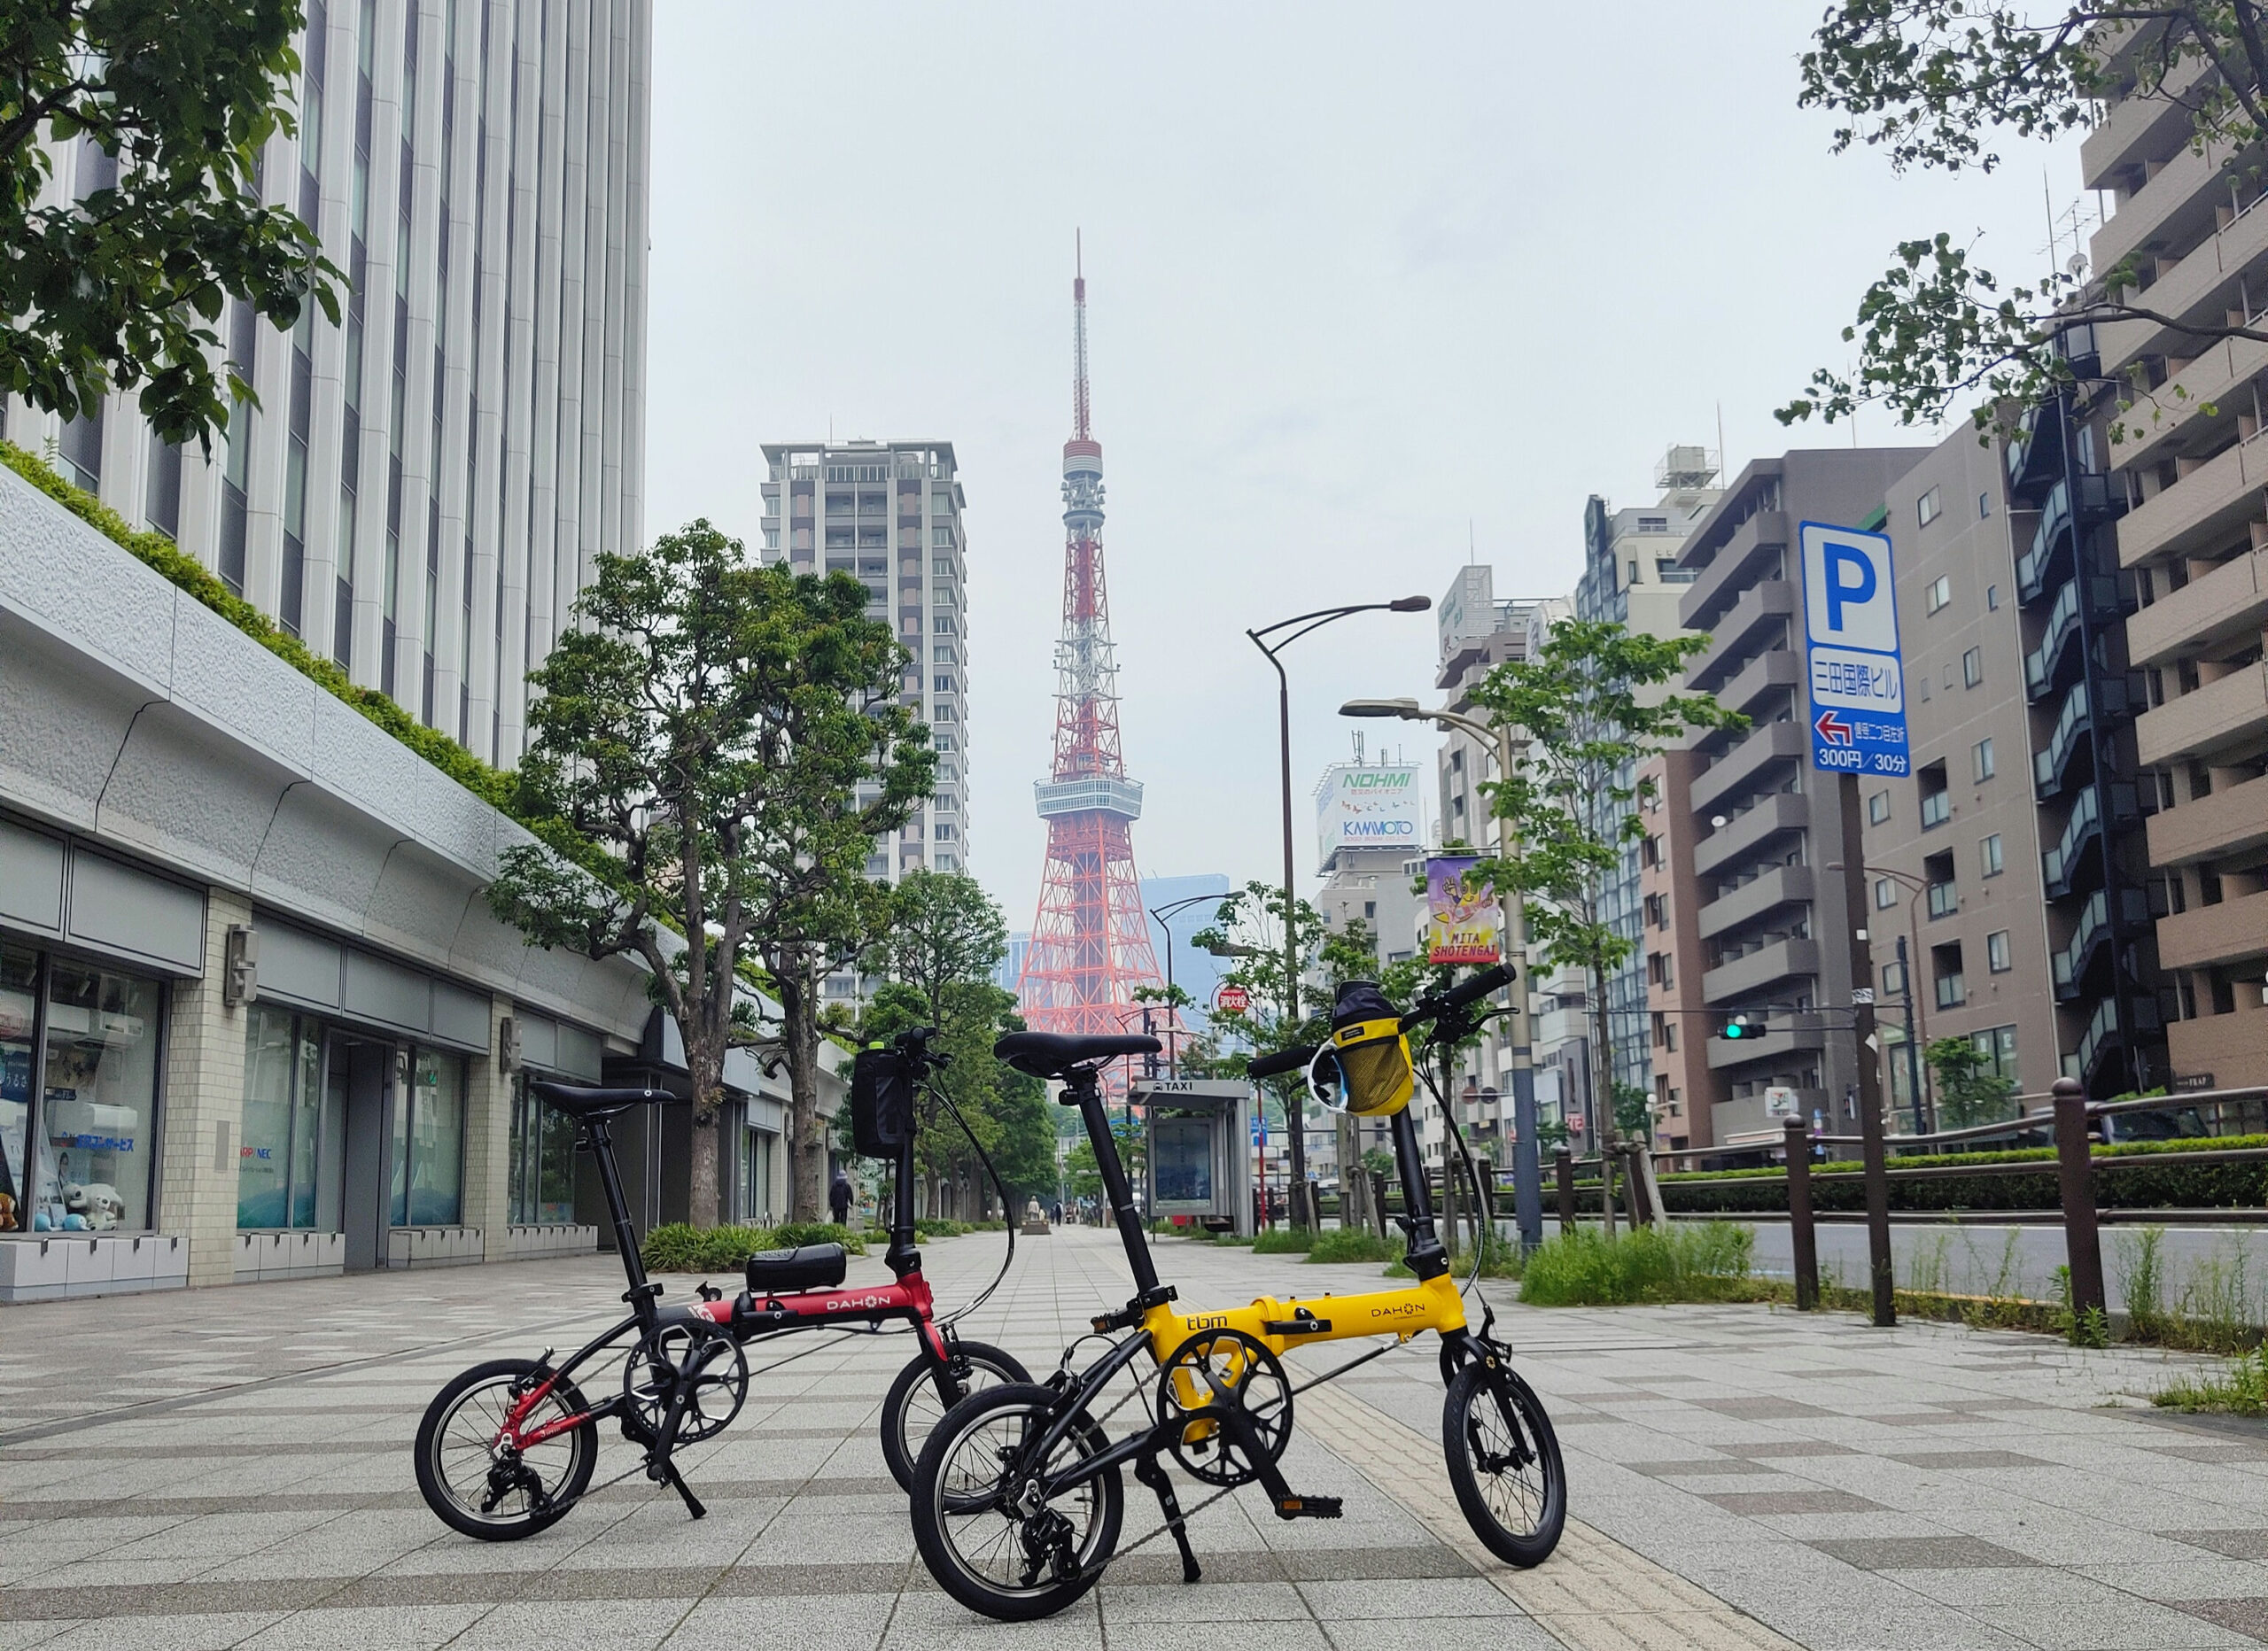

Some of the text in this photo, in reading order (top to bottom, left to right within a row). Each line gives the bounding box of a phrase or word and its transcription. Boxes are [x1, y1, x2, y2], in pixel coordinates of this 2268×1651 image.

[1823, 542, 1876, 632] P
[1814, 661, 1898, 701] 三田国際ビル
[1342, 772, 1410, 788] NOHMI
[1451, 933, 1480, 944] MITA
[1433, 944, 1495, 957] SHOTENGAI
[1220, 995, 1247, 1008] 消火栓
[1165, 1081, 1192, 1091] TAXI
[257, 1148, 272, 1159] NEC
[827, 1295, 890, 1310] DAHON
[1371, 1303, 1425, 1317] DAHON
